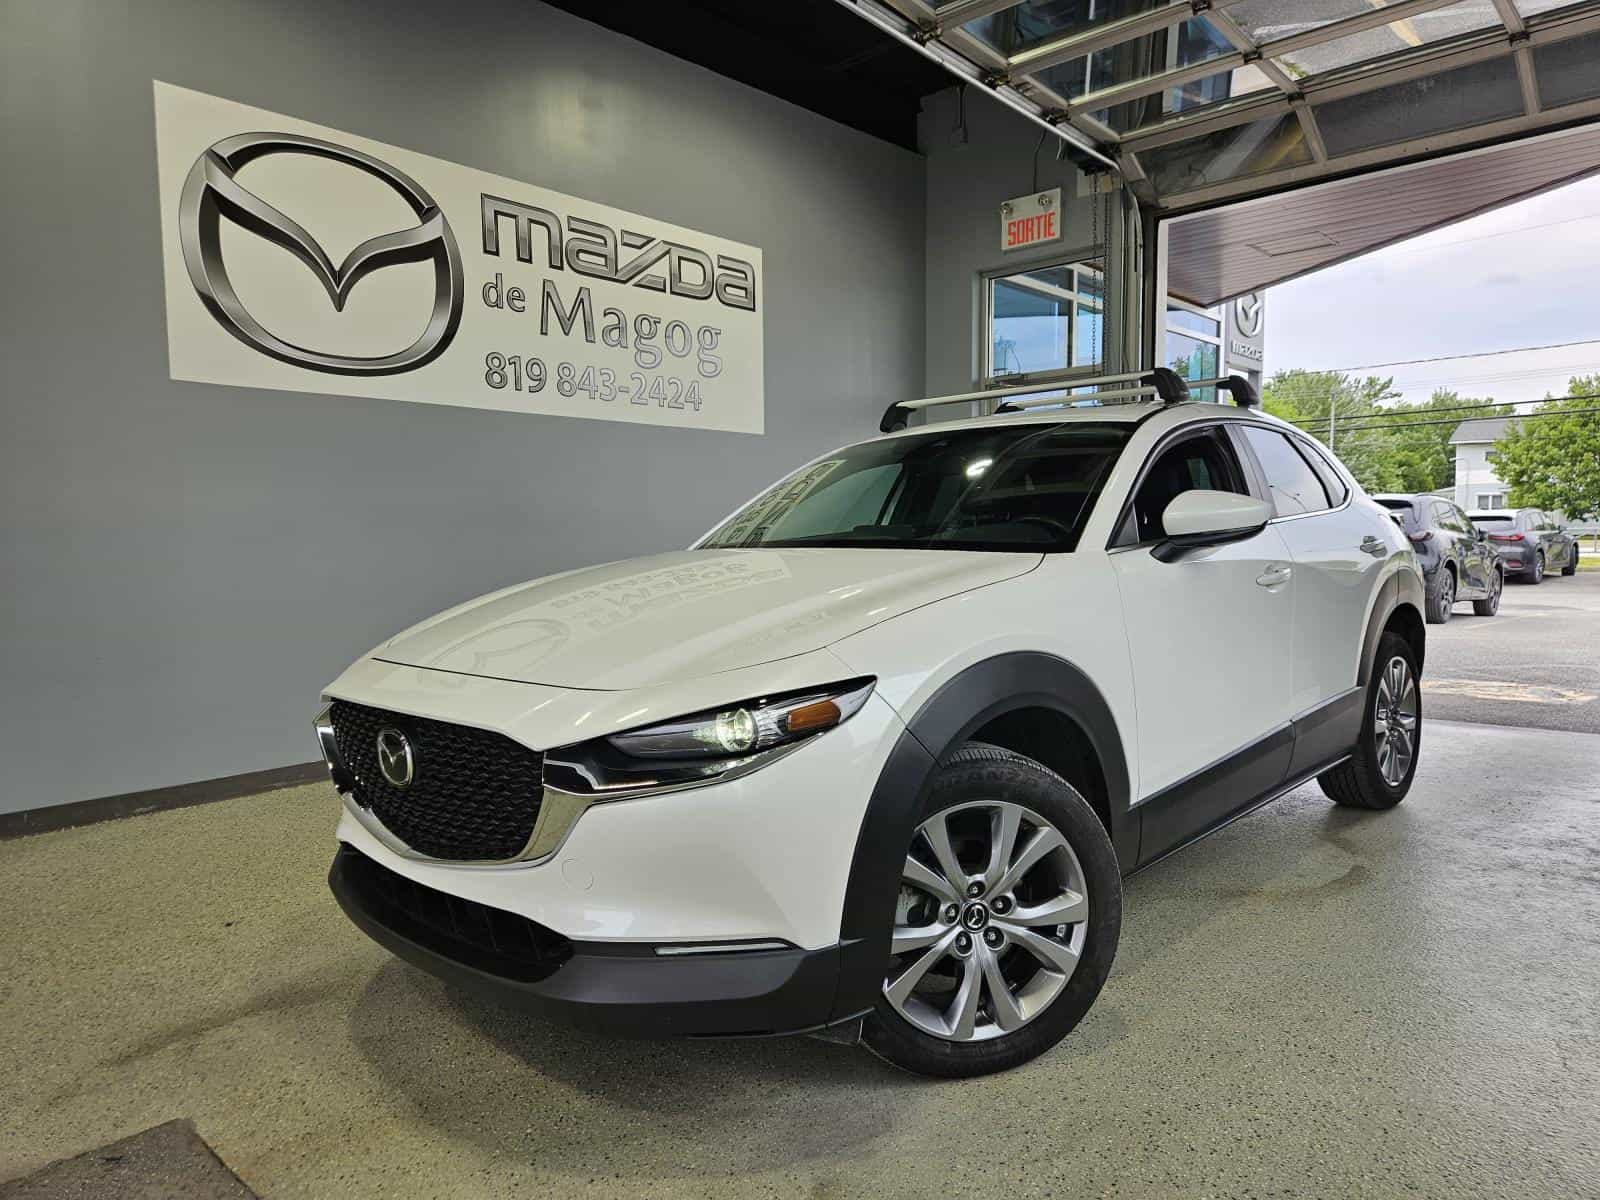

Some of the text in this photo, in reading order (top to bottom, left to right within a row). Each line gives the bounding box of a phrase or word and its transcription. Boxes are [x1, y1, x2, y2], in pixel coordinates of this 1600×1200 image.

[1007, 211, 1056, 247] SORTIE
[482, 273, 723, 378] de Magog
[485, 352, 702, 411] 819 843-2424
